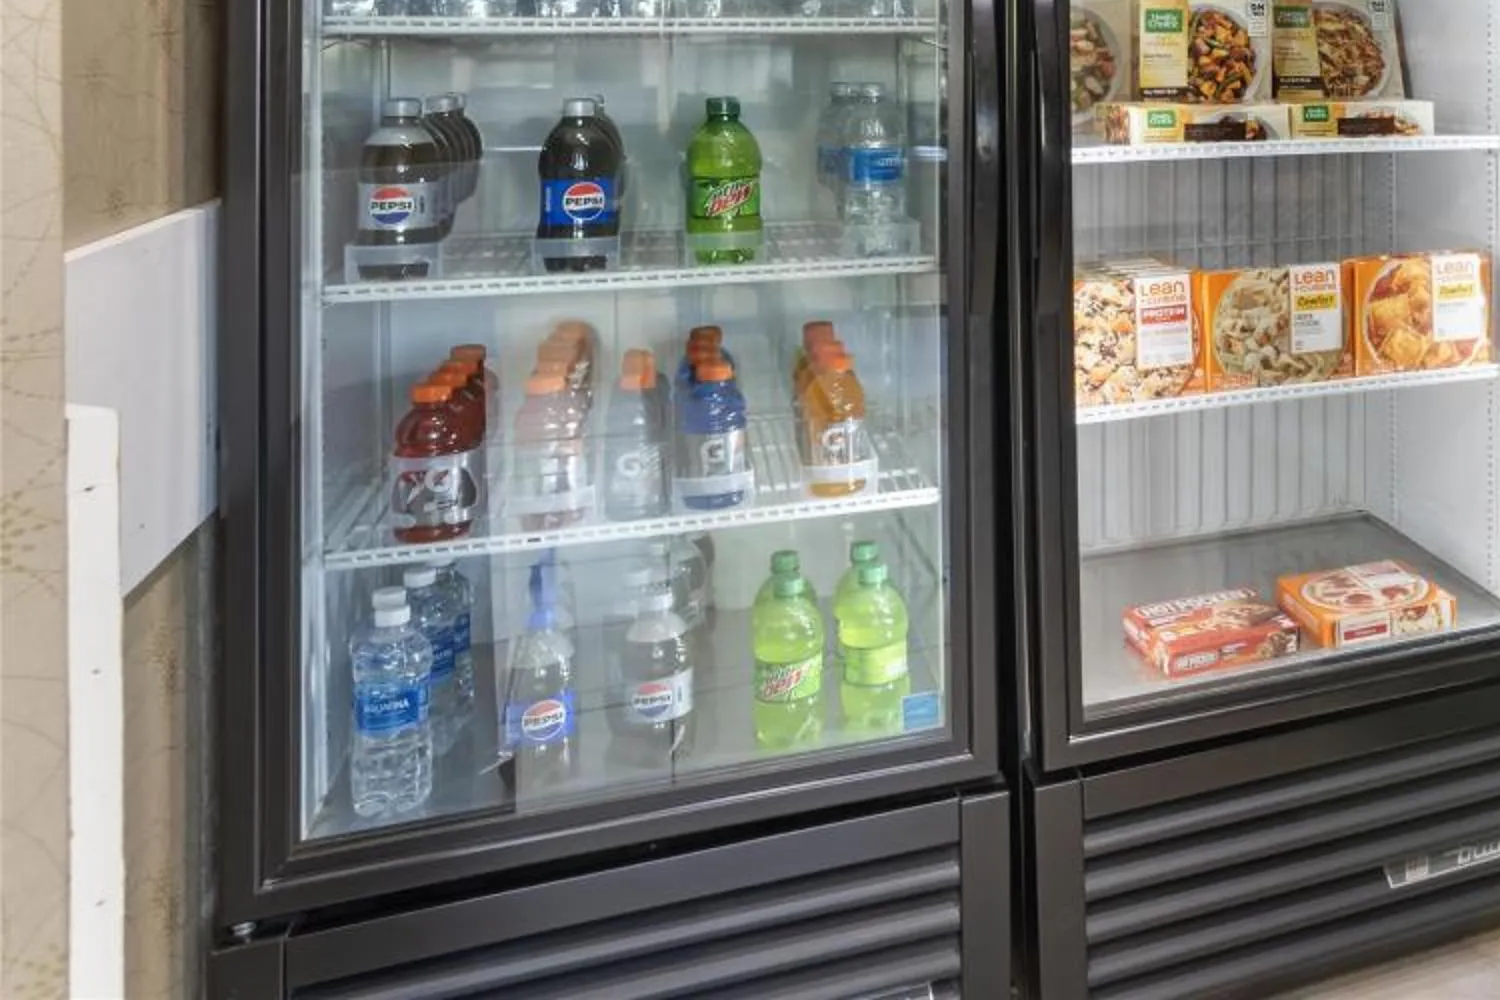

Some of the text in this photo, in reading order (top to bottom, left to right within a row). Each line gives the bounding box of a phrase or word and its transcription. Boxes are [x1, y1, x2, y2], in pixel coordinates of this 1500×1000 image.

[370, 199, 413, 211] PEPSI
[565, 195, 603, 206] PEPSI
[524, 710, 563, 726] PEPSI
